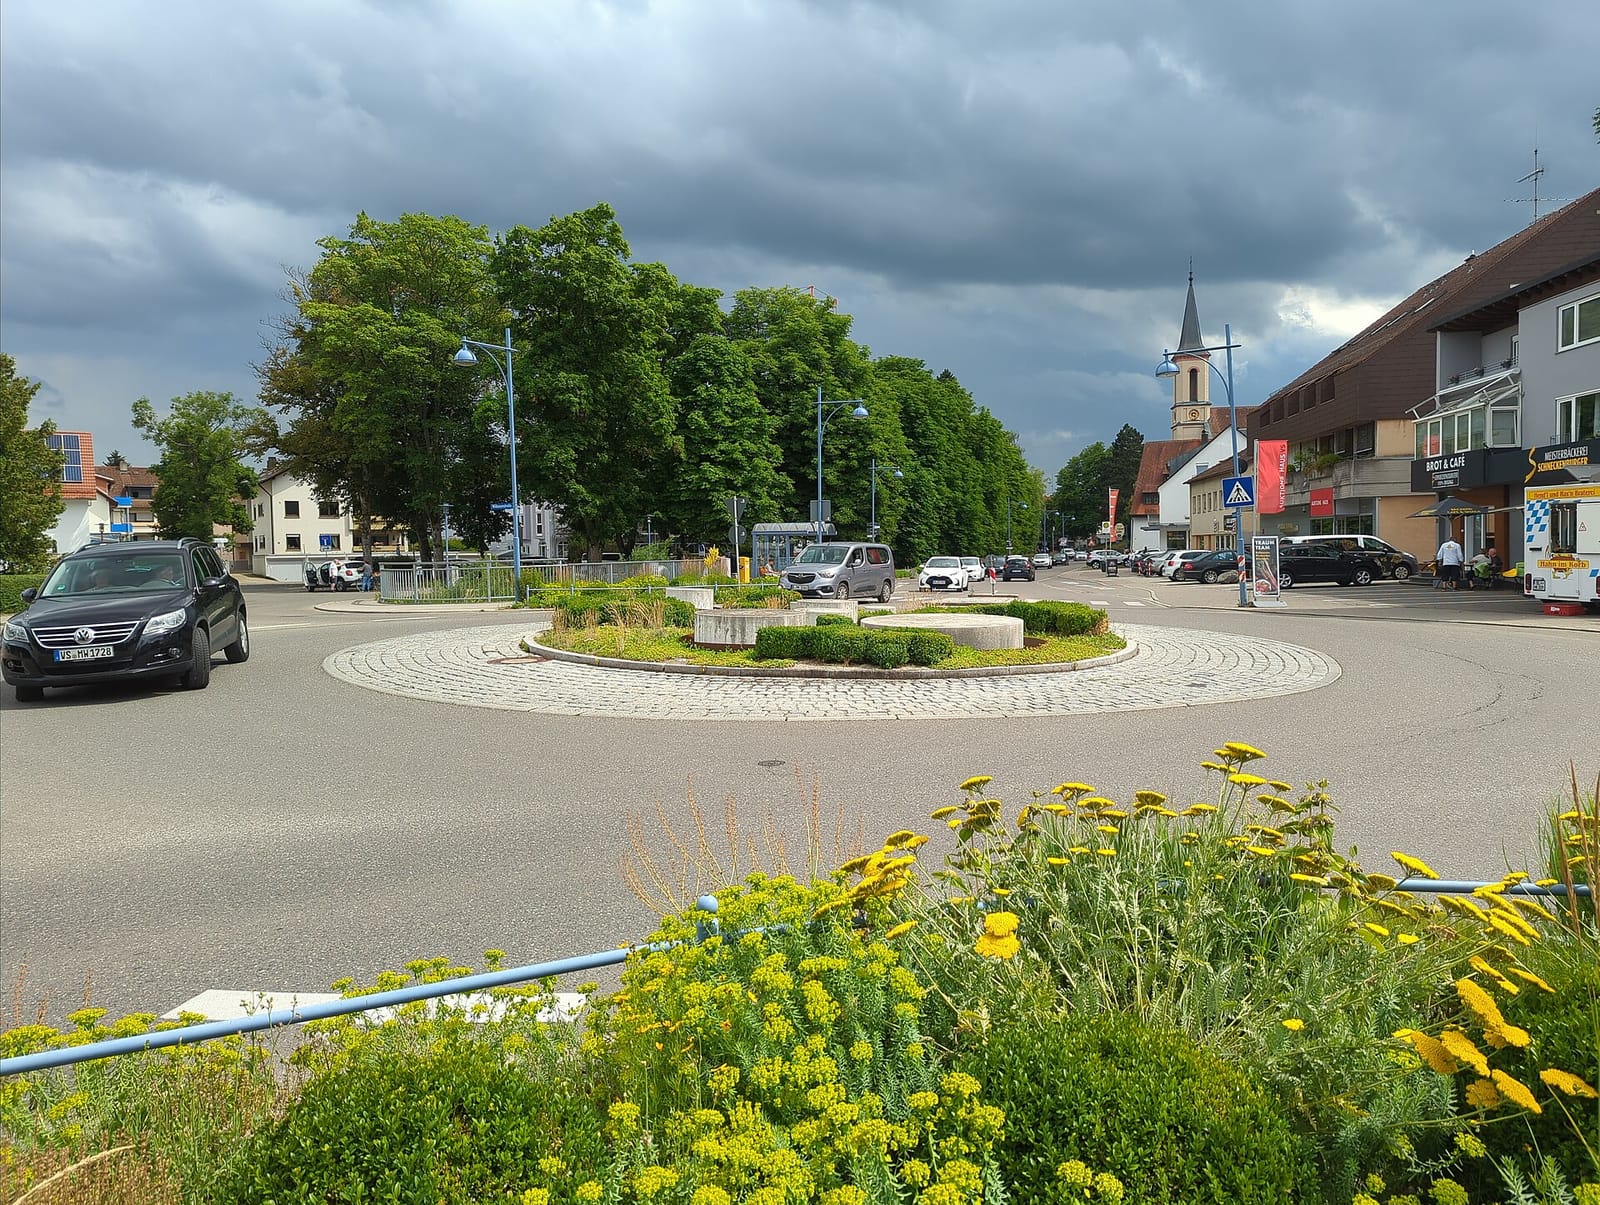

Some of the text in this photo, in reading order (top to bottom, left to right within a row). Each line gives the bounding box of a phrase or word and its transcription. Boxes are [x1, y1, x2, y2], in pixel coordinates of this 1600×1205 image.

[1544, 446, 1588, 461] MEISTERBÄCKEREI
[1426, 453, 1465, 472] BROT & CAFÉ
[60, 650, 71, 659] VS
